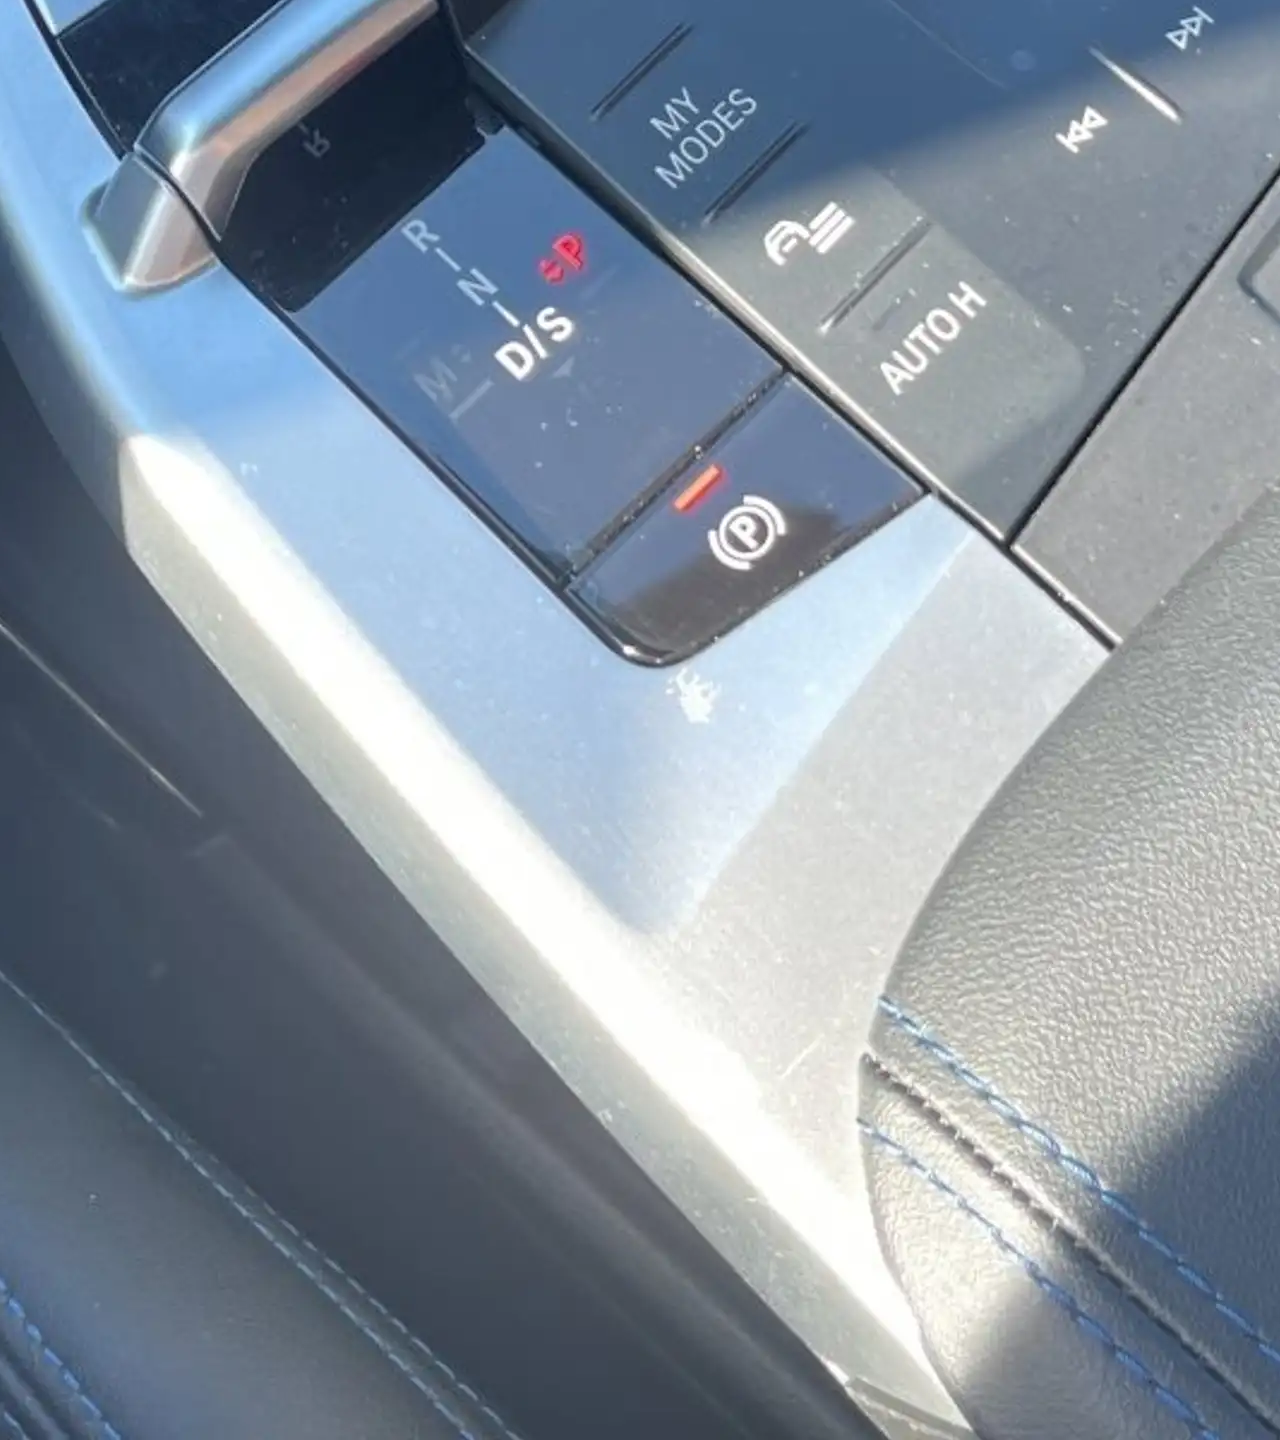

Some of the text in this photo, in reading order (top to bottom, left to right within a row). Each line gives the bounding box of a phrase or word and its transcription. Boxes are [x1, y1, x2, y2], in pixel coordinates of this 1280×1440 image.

[650, 87, 700, 140] MY
[654, 88, 758, 188] MODES
[400, 219, 440, 253] R
[456, 268, 500, 306] N
[494, 306, 574, 382] D/S
[880, 280, 988, 395] AUTO H
